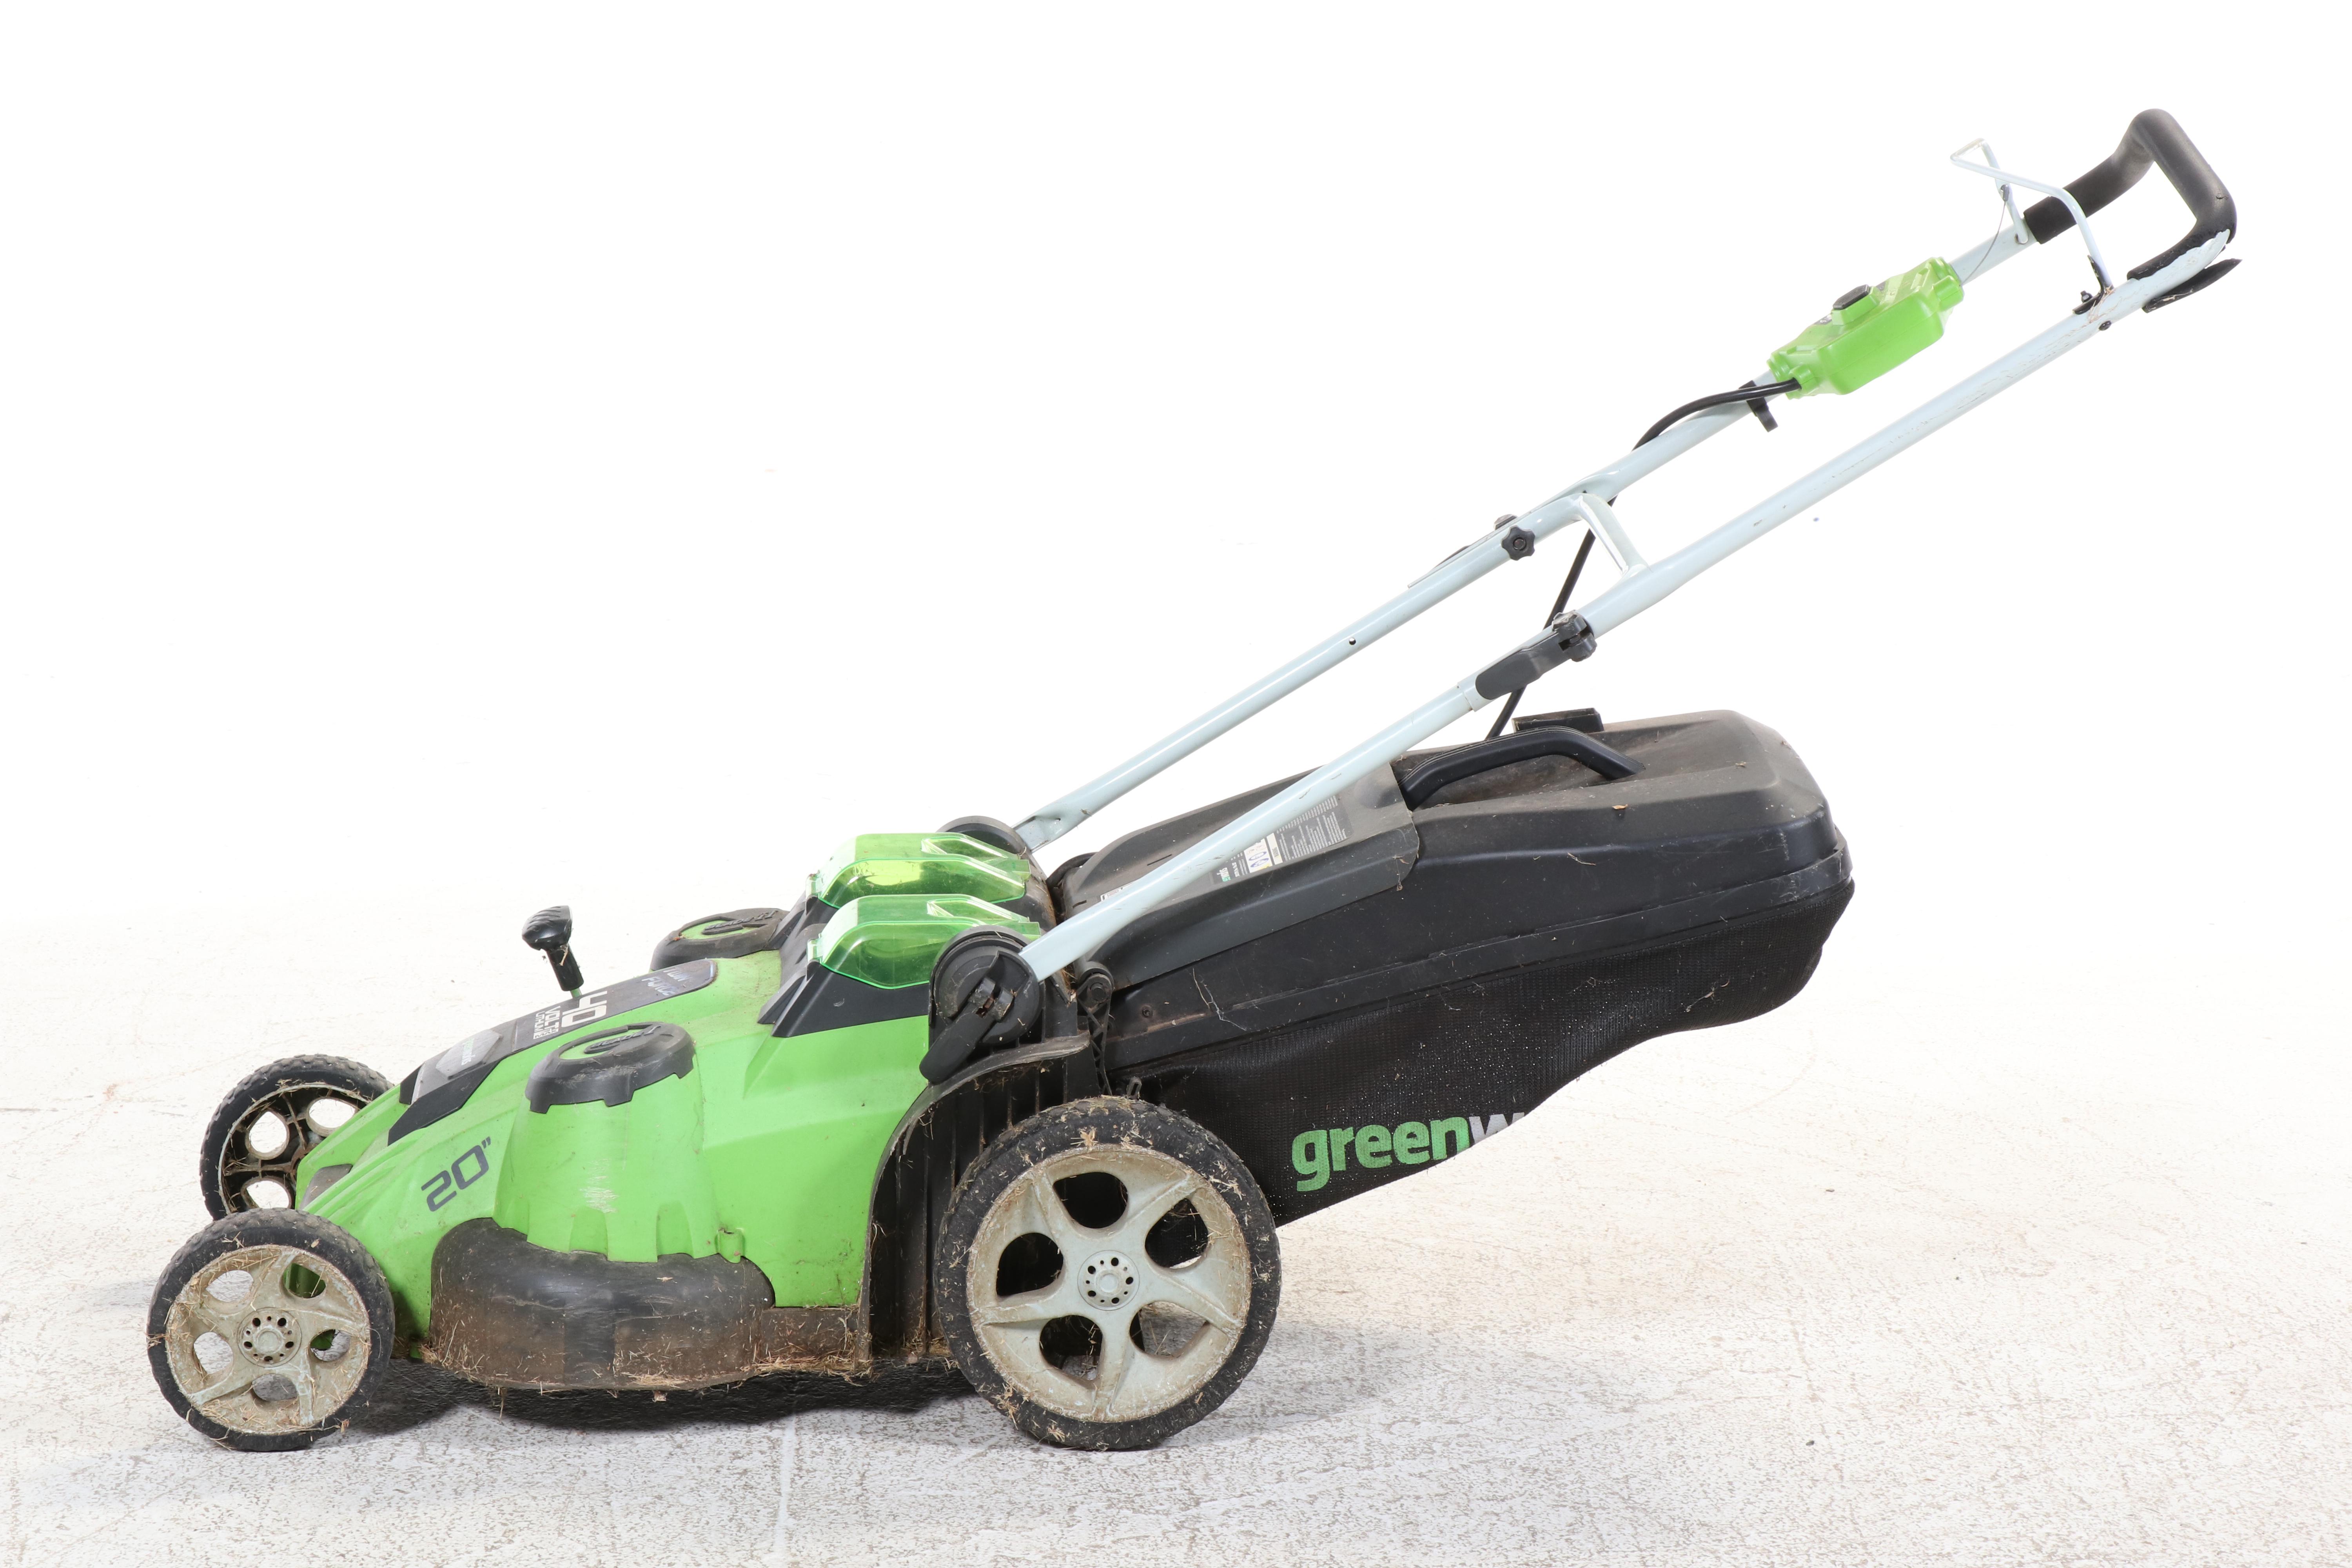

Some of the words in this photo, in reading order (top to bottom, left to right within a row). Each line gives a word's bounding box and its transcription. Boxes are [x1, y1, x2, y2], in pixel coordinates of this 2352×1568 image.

[641, 976, 677, 996] FORCE
[544, 1005, 561, 1030] VOLT
[561, 990, 608, 1028] 40
[421, 1136, 491, 1212] 20"
